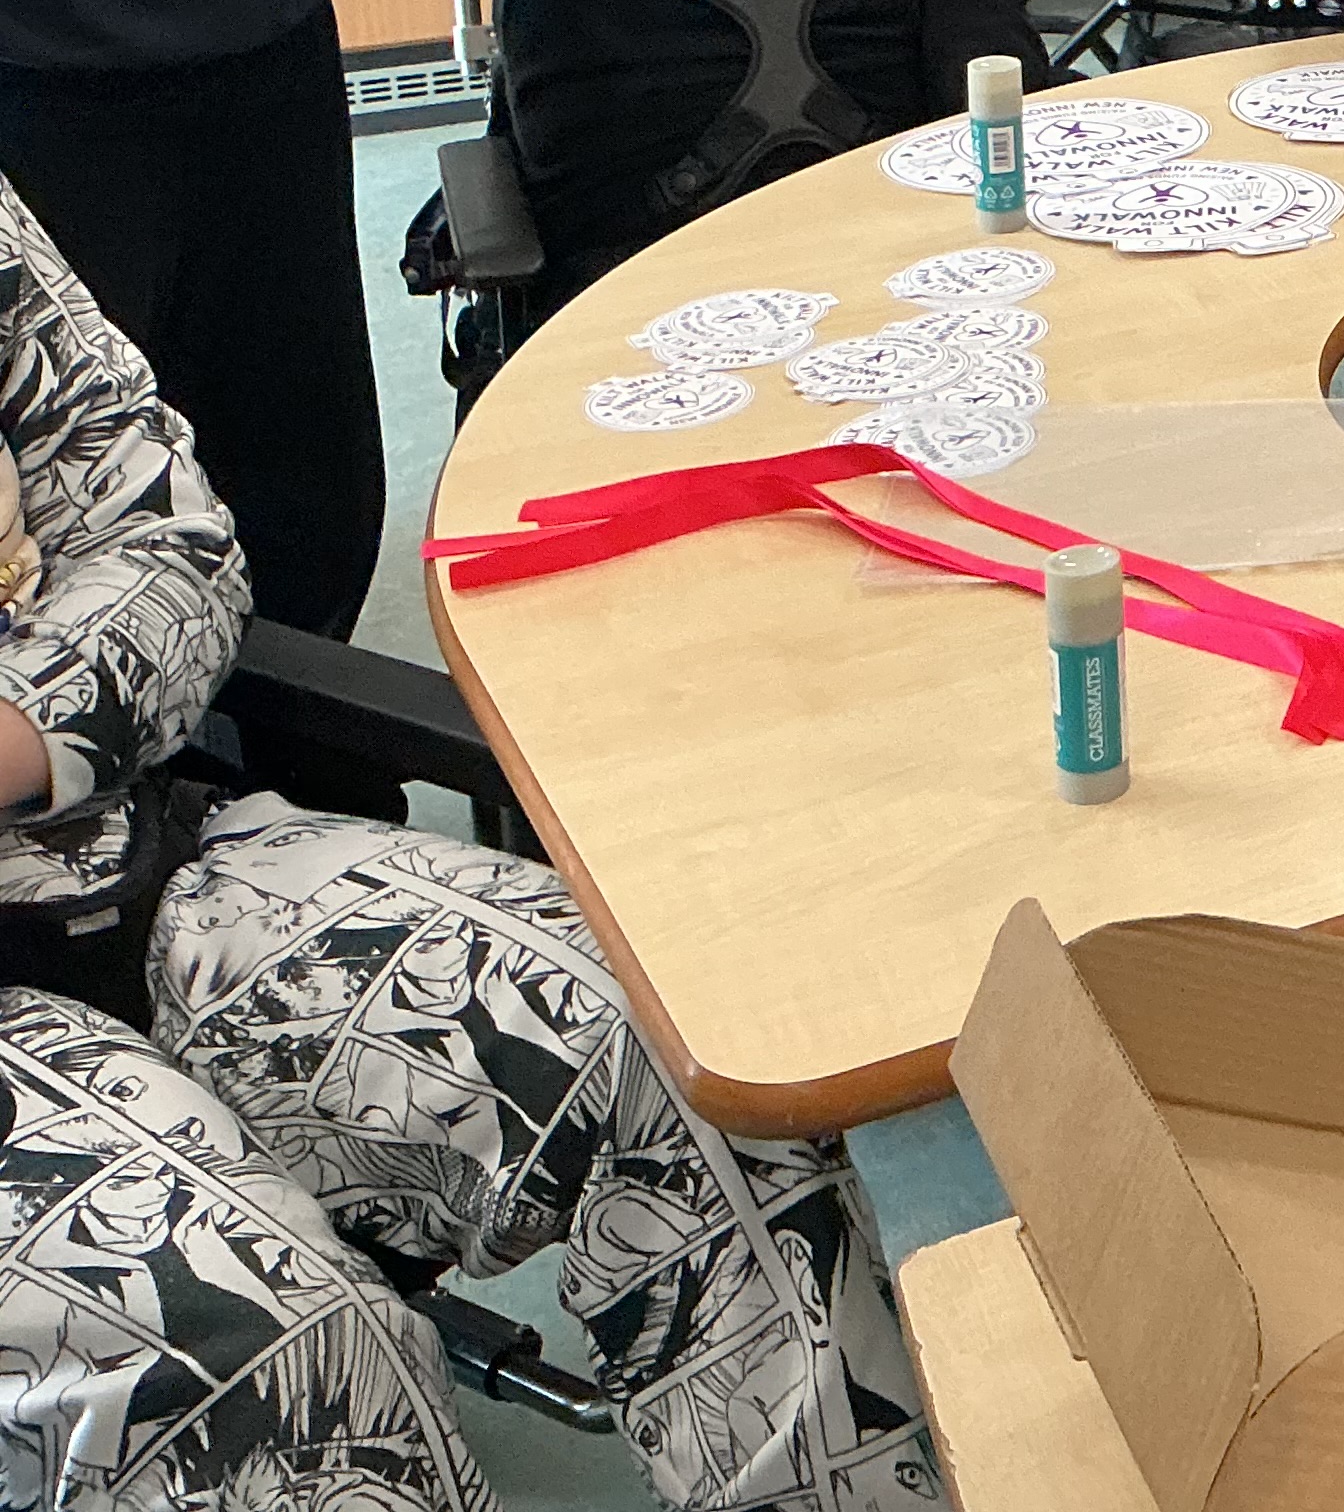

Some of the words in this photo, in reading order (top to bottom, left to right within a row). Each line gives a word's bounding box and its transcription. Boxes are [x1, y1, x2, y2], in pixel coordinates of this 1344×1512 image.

[1254, 113, 1328, 131] WALK
[1124, 141, 1182, 163] KILT
[1072, 206, 1238, 223] INNOWALK
[1071, 221, 1152, 236] WALK
[1167, 216, 1243, 236] KILT
[1086, 656, 1105, 762] CLASSMATES
